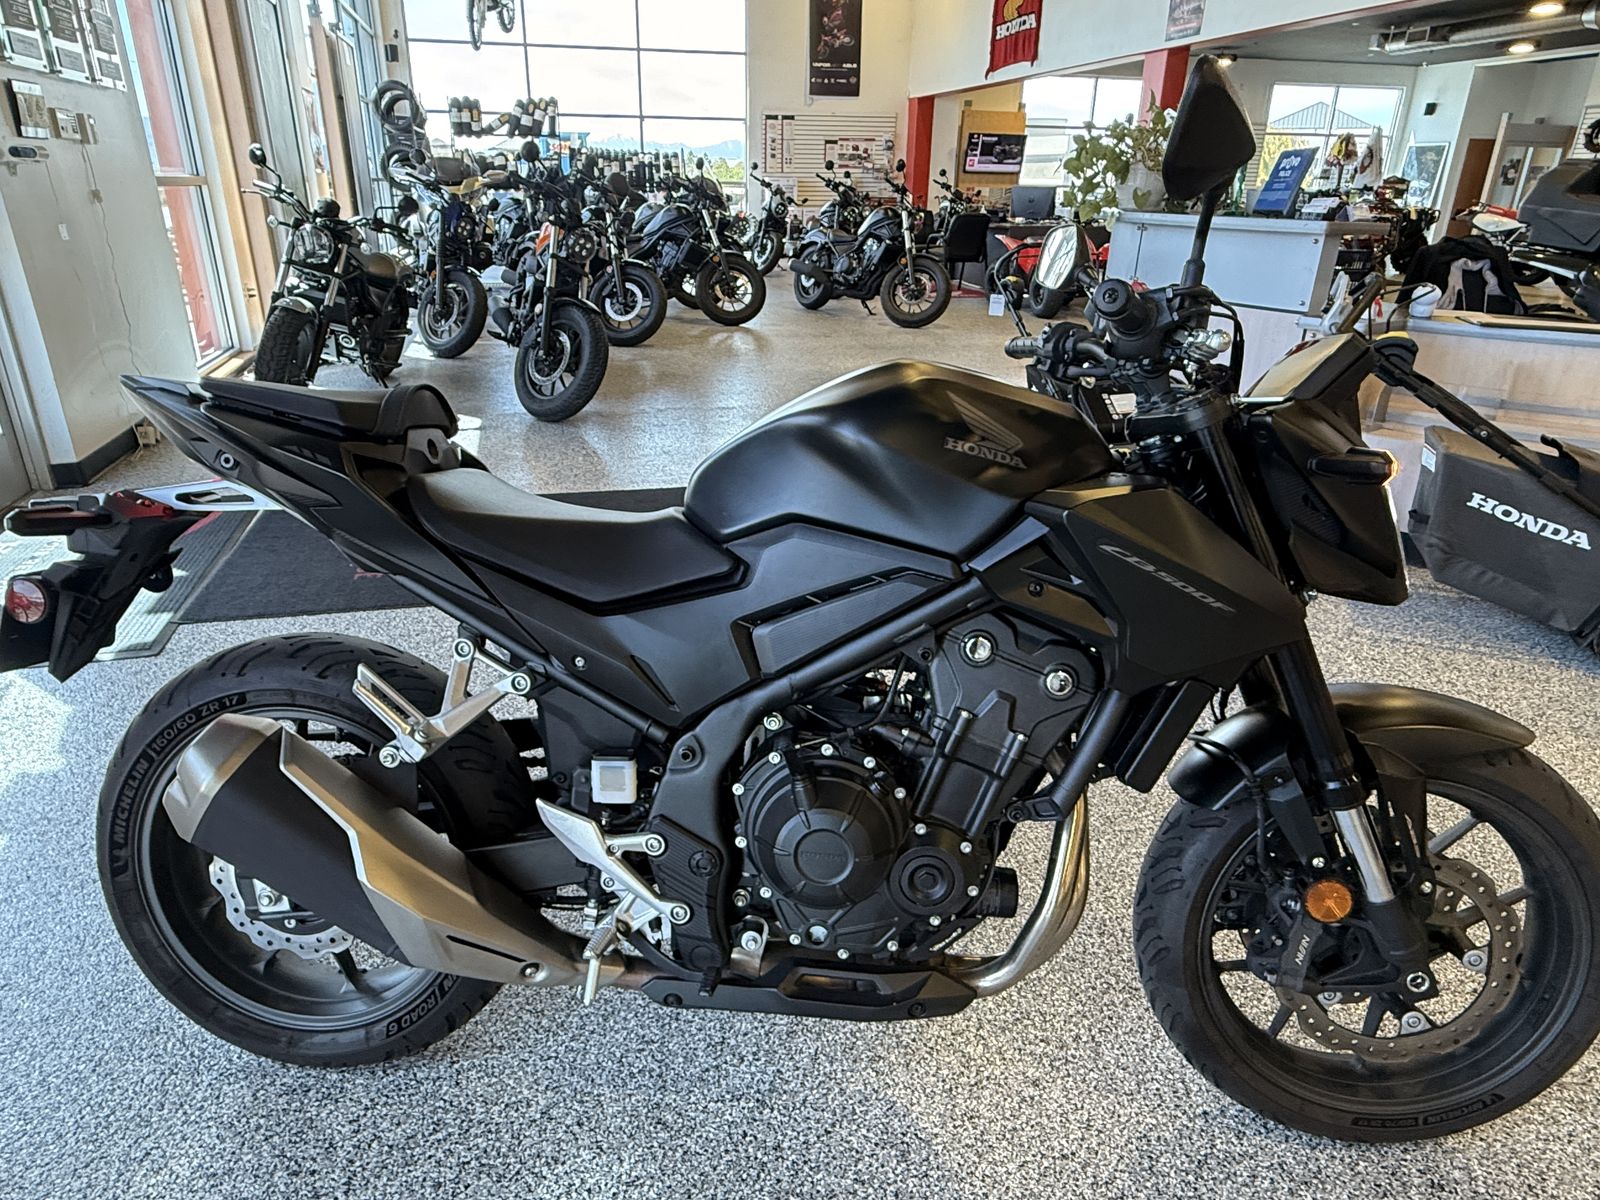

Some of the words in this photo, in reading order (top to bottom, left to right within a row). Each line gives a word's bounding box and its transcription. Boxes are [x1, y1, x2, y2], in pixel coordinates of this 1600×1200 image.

[995, 13, 1037, 40] HONDA
[944, 437, 1028, 469] HONDA
[1465, 492, 1591, 551] HONDA
[1099, 545, 1236, 612] CB500F
[112, 758, 149, 844] MICHELIN
[151, 713, 196, 751] 160/60
[200, 702, 220, 717] ZR
[223, 696, 239, 707] 17
[401, 996, 436, 1028] ROAD
[387, 1023, 398, 1036] 6
